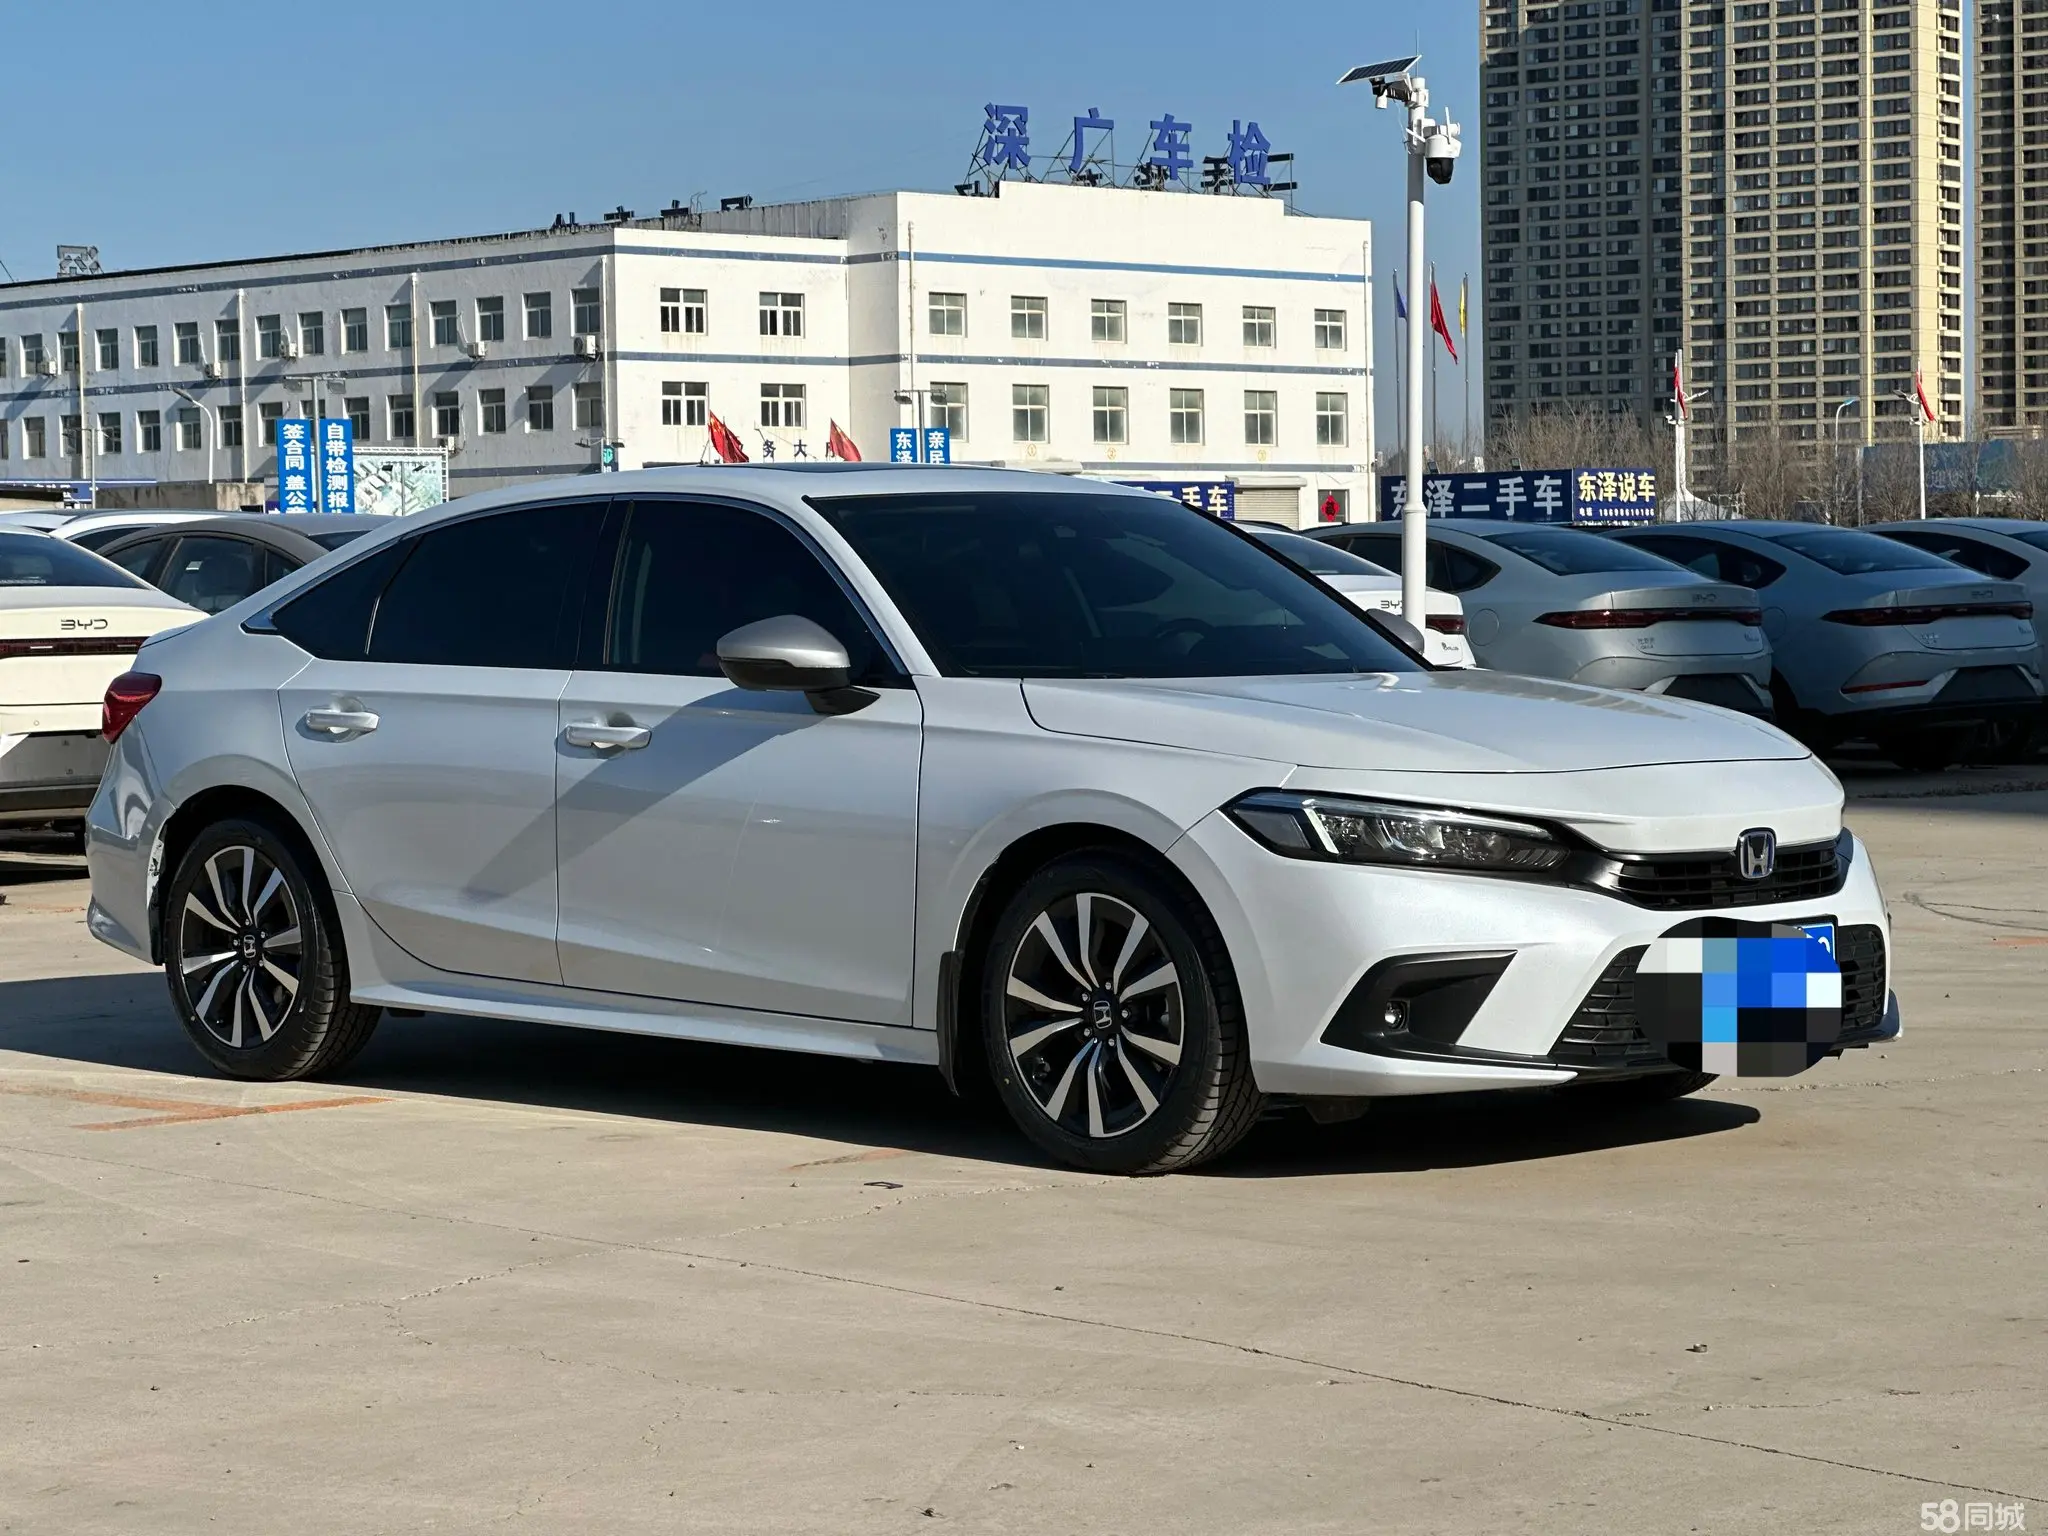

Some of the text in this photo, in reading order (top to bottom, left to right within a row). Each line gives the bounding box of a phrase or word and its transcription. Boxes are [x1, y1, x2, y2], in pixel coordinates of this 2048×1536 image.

[983, 102, 1271, 185] 深广车检
[283, 423, 305, 470] 签合同
[325, 423, 349, 513] 自带检测报
[1577, 471, 1656, 502] 东泽说车
[1380, 600, 1403, 609] BY
[60, 618, 109, 631] BYD
